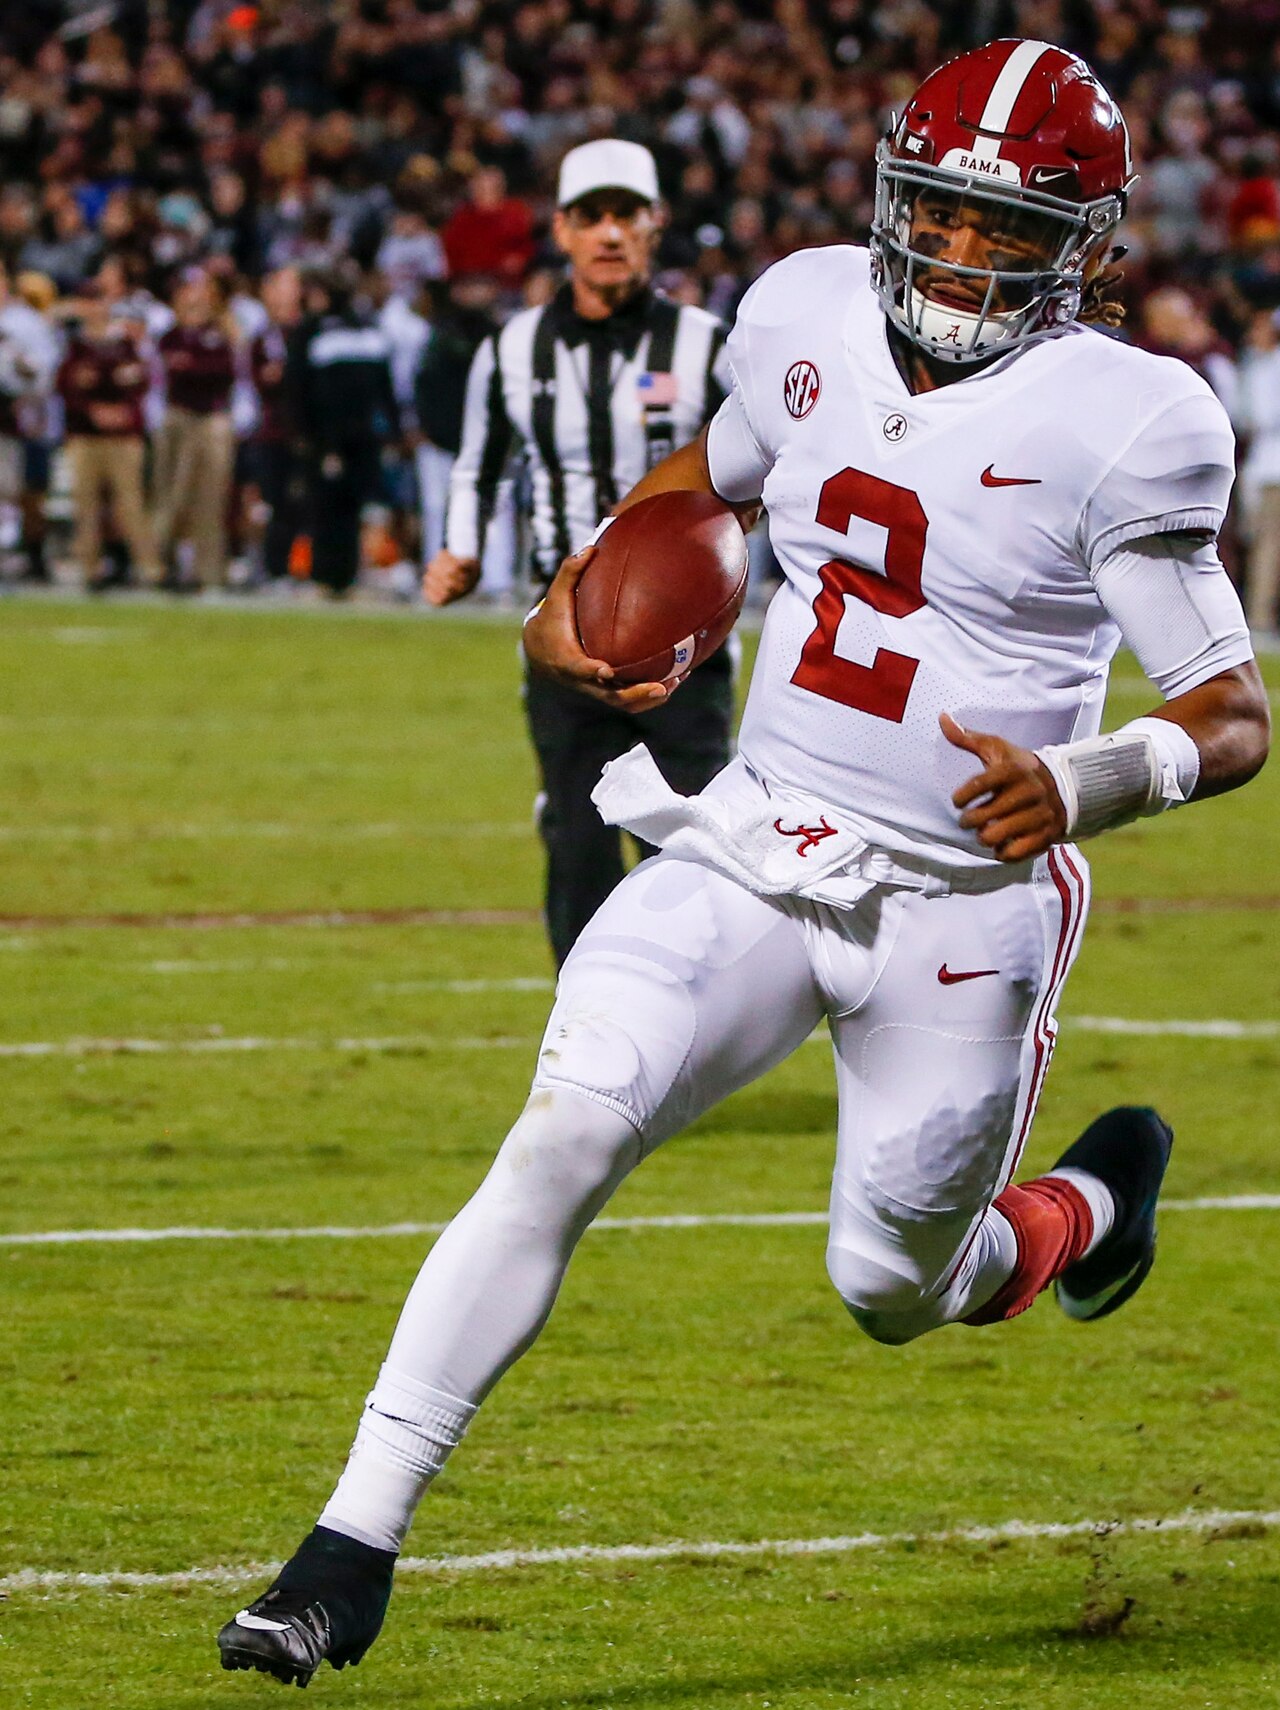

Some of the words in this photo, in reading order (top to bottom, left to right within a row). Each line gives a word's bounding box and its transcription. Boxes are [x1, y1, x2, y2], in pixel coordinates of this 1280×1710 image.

[960, 155, 1002, 176] BAMA
[784, 361, 821, 419] SEC
[790, 466, 929, 724] 2
